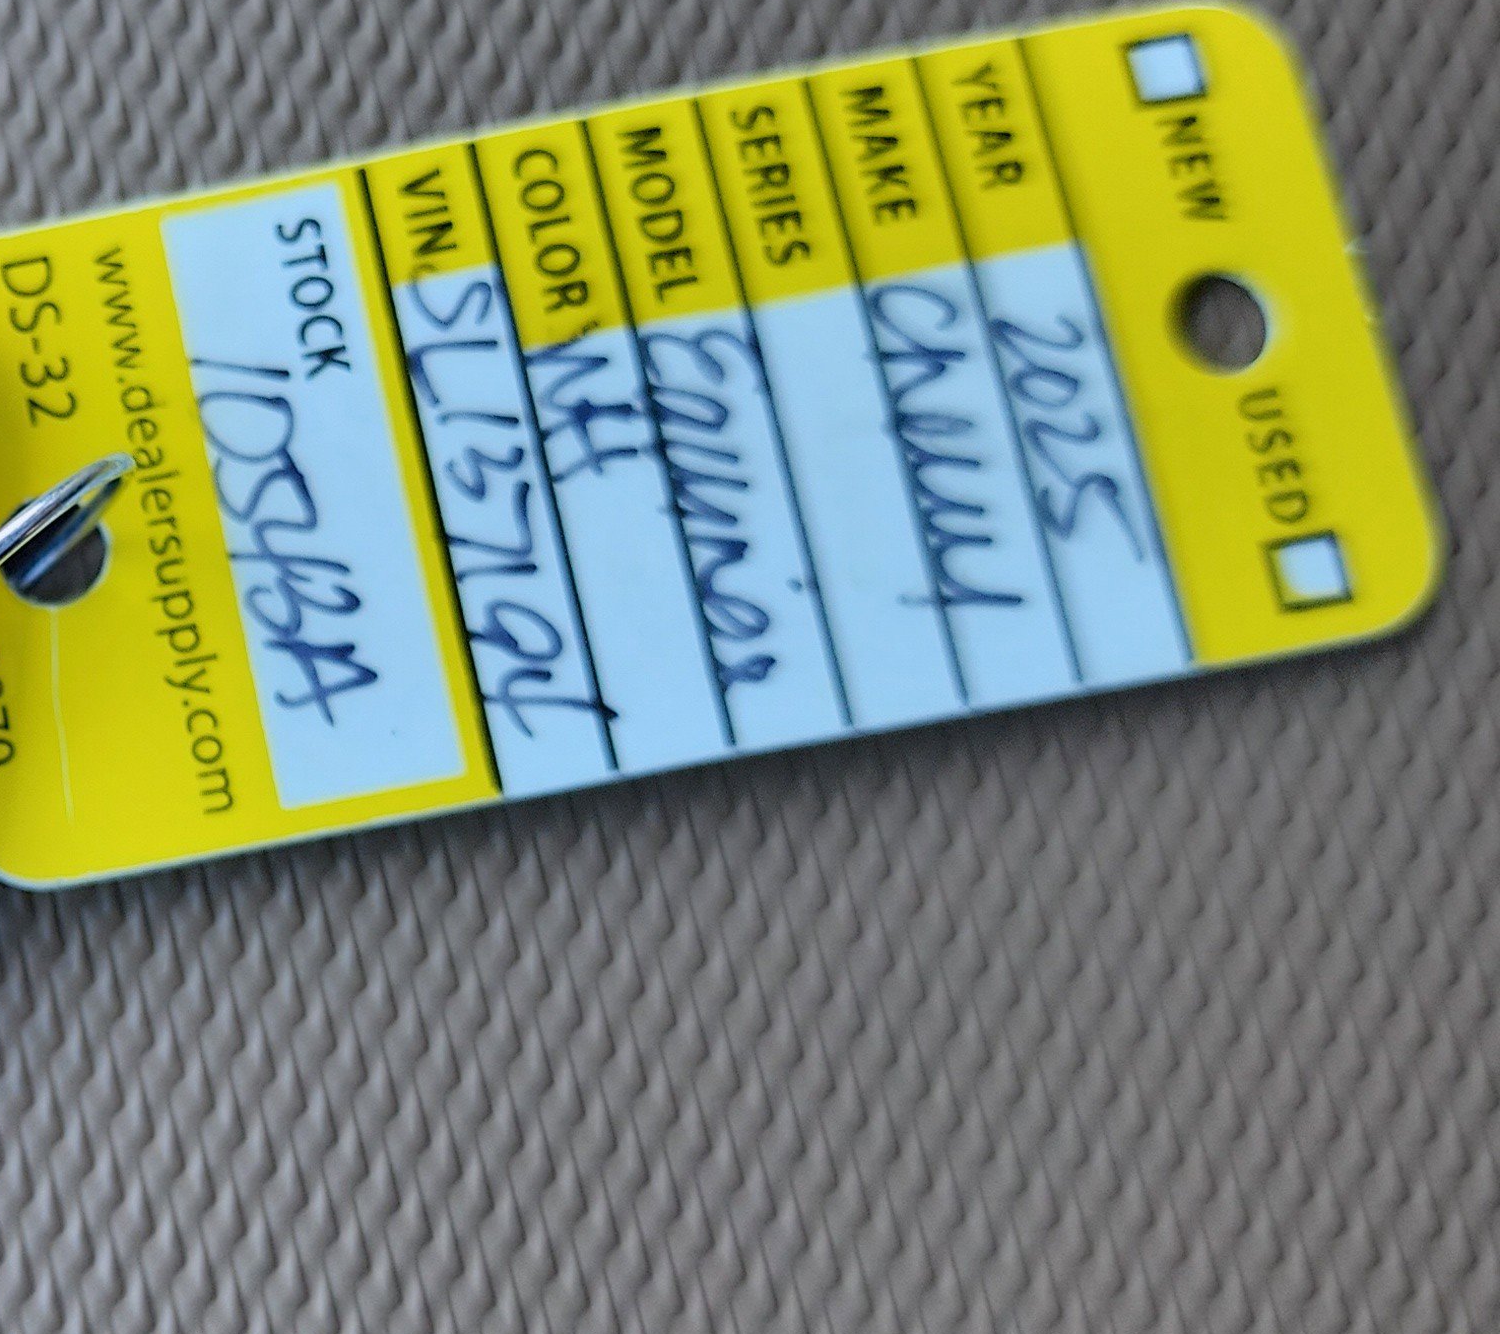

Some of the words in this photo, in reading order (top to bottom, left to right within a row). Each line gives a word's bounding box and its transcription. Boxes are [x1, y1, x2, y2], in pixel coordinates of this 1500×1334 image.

[730, 104, 812, 268] SERIES
[839, 85, 918, 226] MAKE
[953, 63, 1023, 191] YEAR
[1154, 114, 1228, 222] NEW
[399, 168, 458, 258] VIN
[513, 148, 590, 315] COLOR
[617, 126, 700, 302] MODEL
[1, 254, 77, 428] DS-32
[275, 217, 350, 380] STOCK
[990, 313, 1145, 564] 2025
[1237, 385, 1312, 526] USED
[94, 246, 236, 815] www.dealersupply.com
